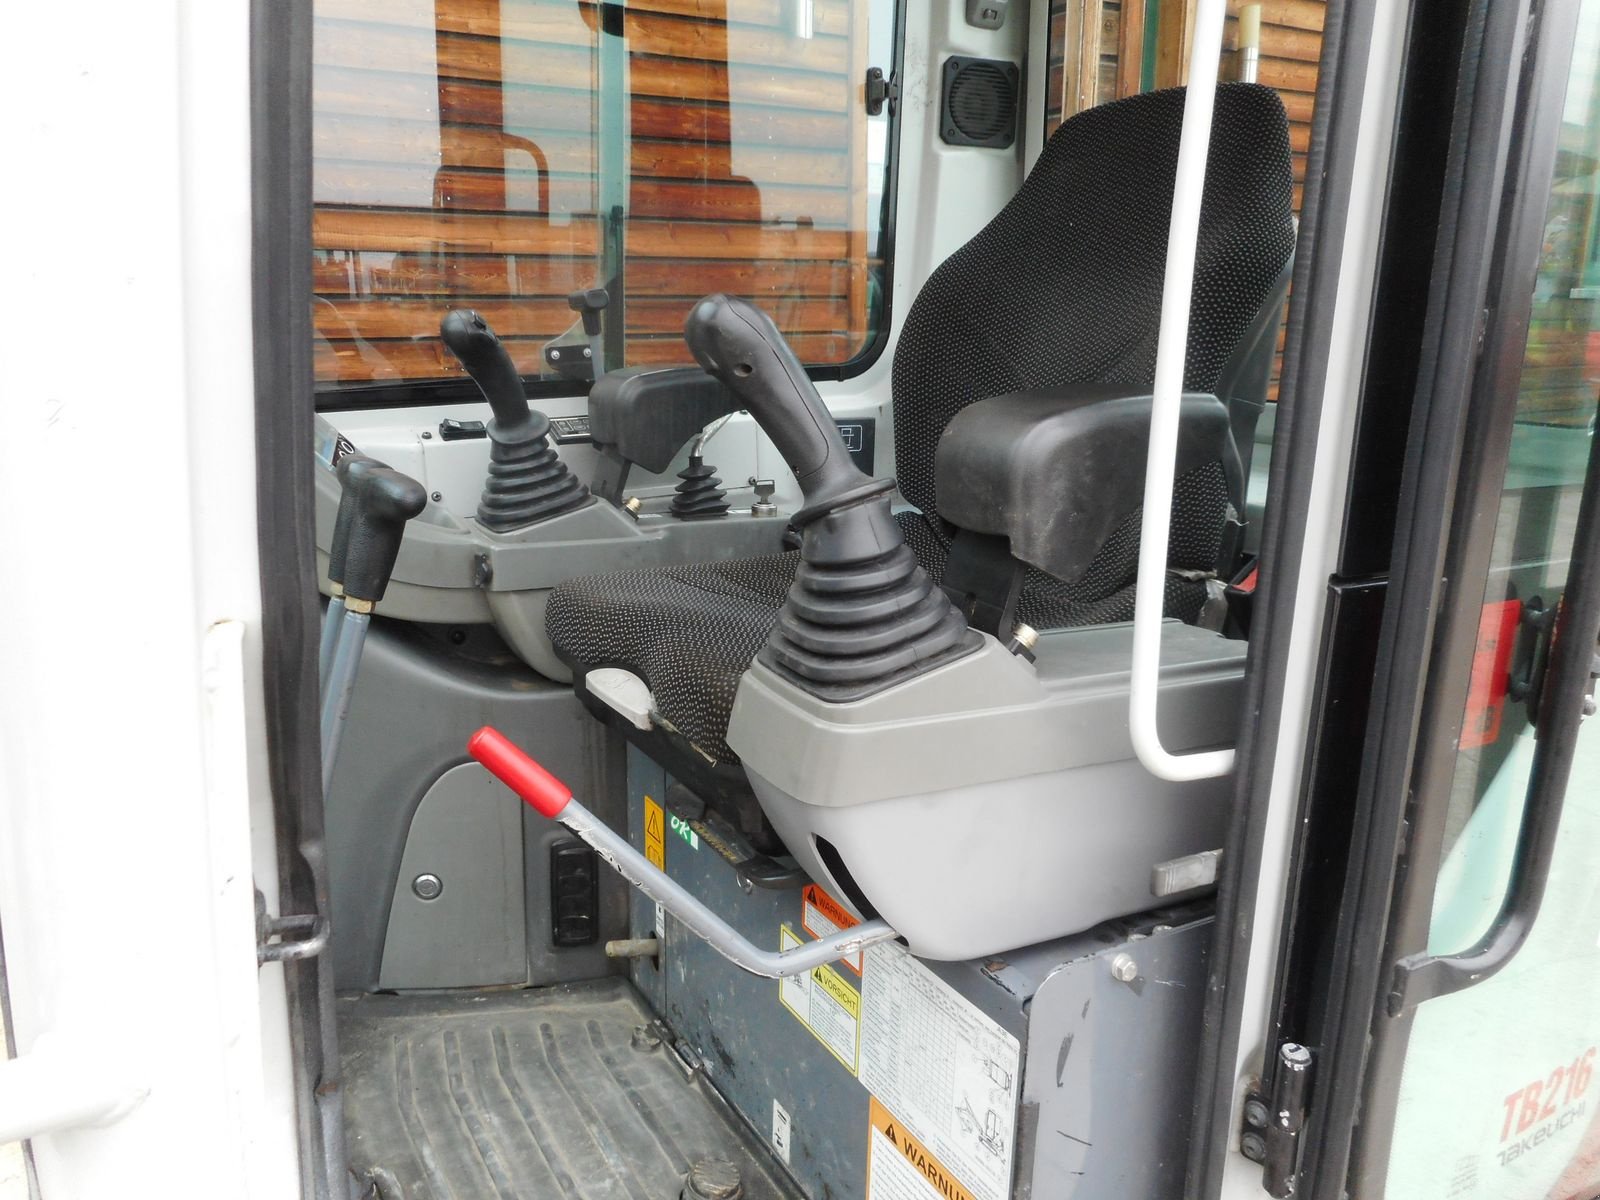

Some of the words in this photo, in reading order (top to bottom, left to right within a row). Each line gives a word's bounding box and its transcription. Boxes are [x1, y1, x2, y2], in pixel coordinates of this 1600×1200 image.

[823, 977, 857, 1011] VORSICHT
[1500, 1046, 1597, 1143] TB216
[903, 1137, 966, 1200] WARNU
